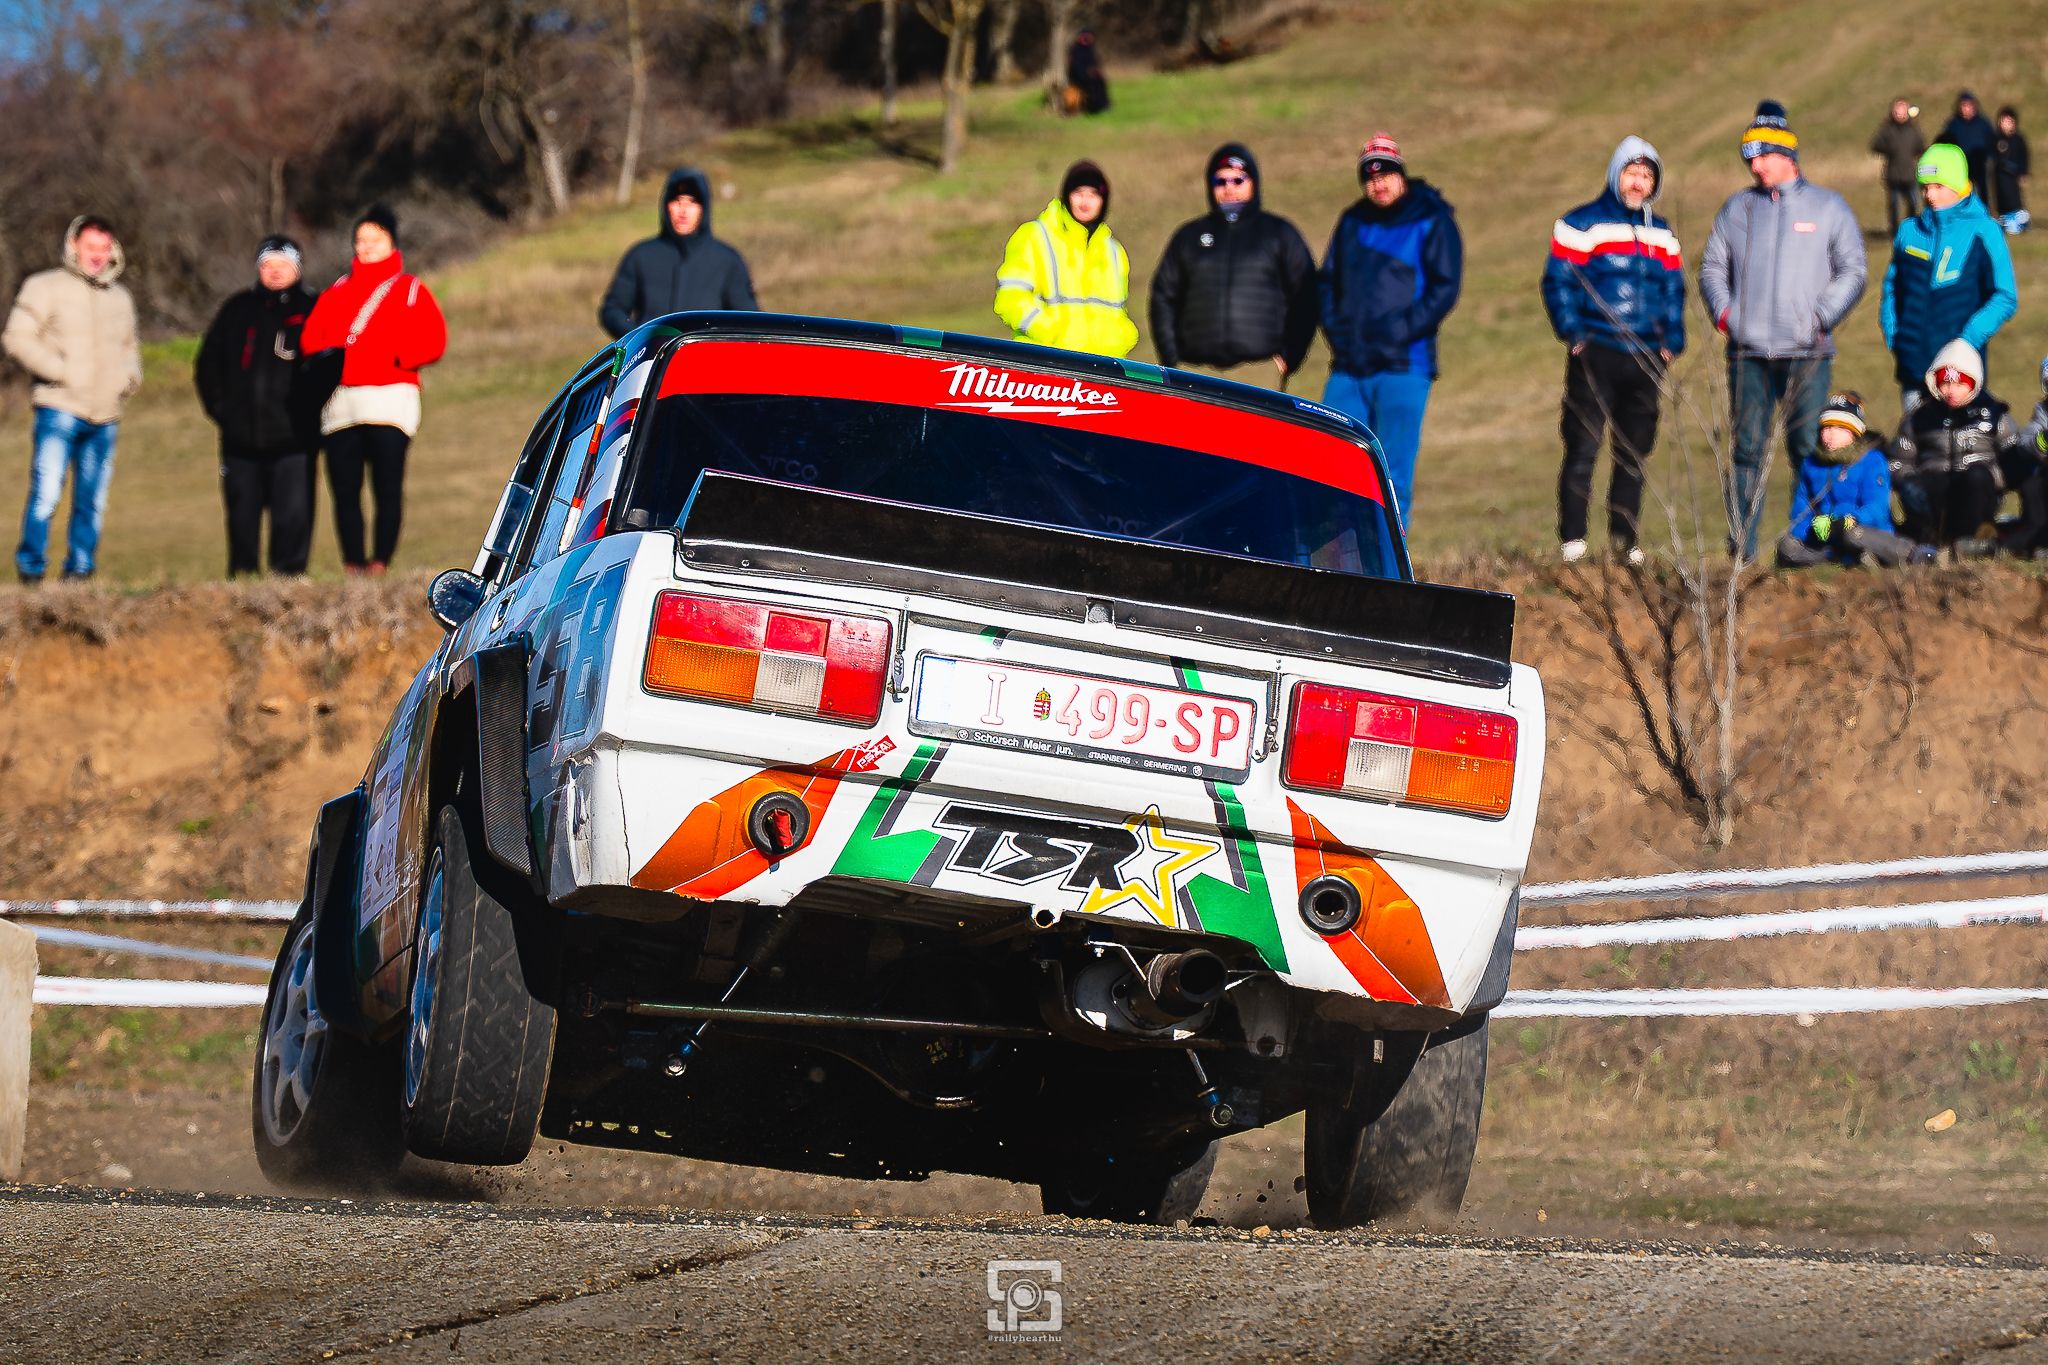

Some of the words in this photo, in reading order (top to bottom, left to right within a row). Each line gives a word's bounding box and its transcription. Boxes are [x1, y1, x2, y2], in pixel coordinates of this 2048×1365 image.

[940, 363, 1118, 406] Milwaukee
[980, 672, 1007, 725] I
[1055, 684, 1240, 758] 499-SP
[973, 731, 1019, 747] Schorsch
[1055, 744, 1074, 756] jun.
[1088, 751, 1131, 764] STARNBERG
[1143, 760, 1187, 773] GERMERING
[936, 803, 1145, 893] TSR
